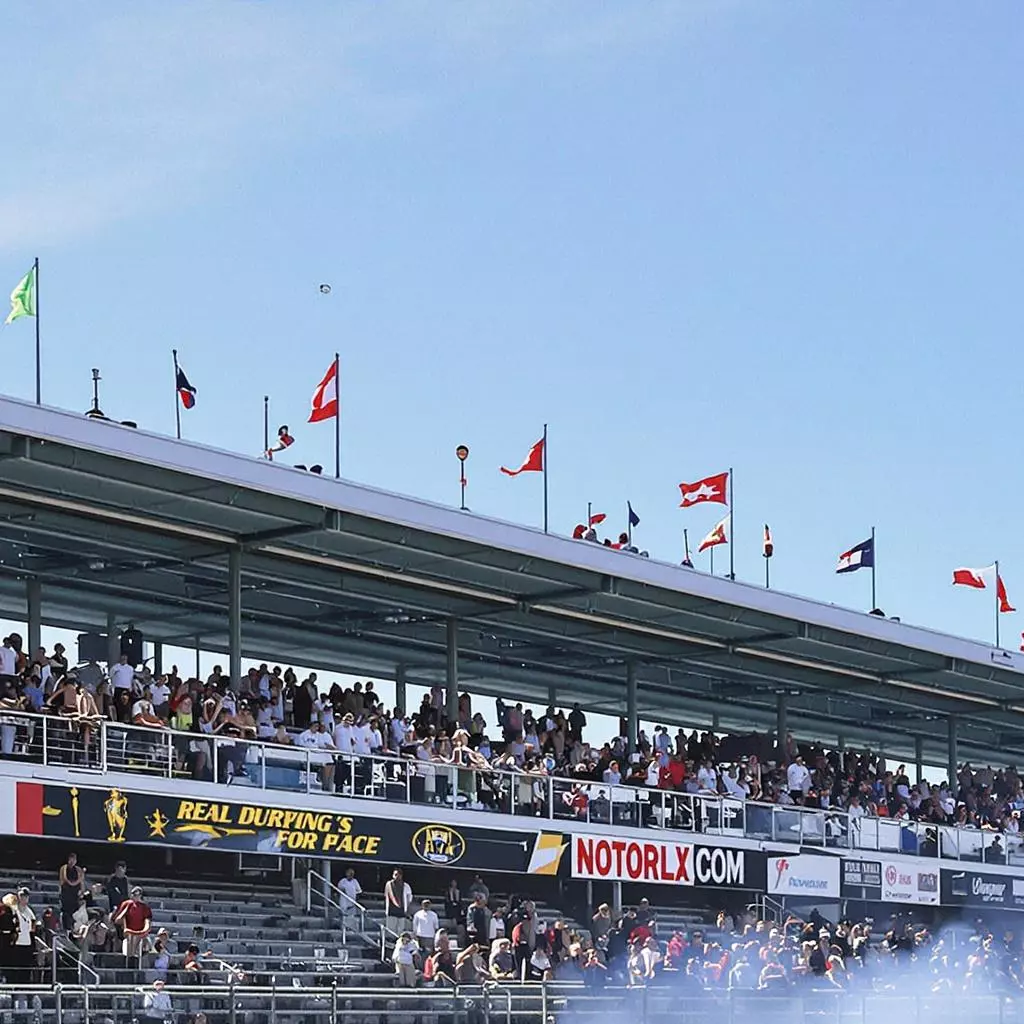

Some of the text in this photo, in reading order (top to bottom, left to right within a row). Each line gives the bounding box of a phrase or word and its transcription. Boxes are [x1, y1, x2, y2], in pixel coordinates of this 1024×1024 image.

[177, 801, 232, 824] REAL
[274, 830, 380, 854] FOR PACE
[577, 838, 744, 885] NOTORLX COM
